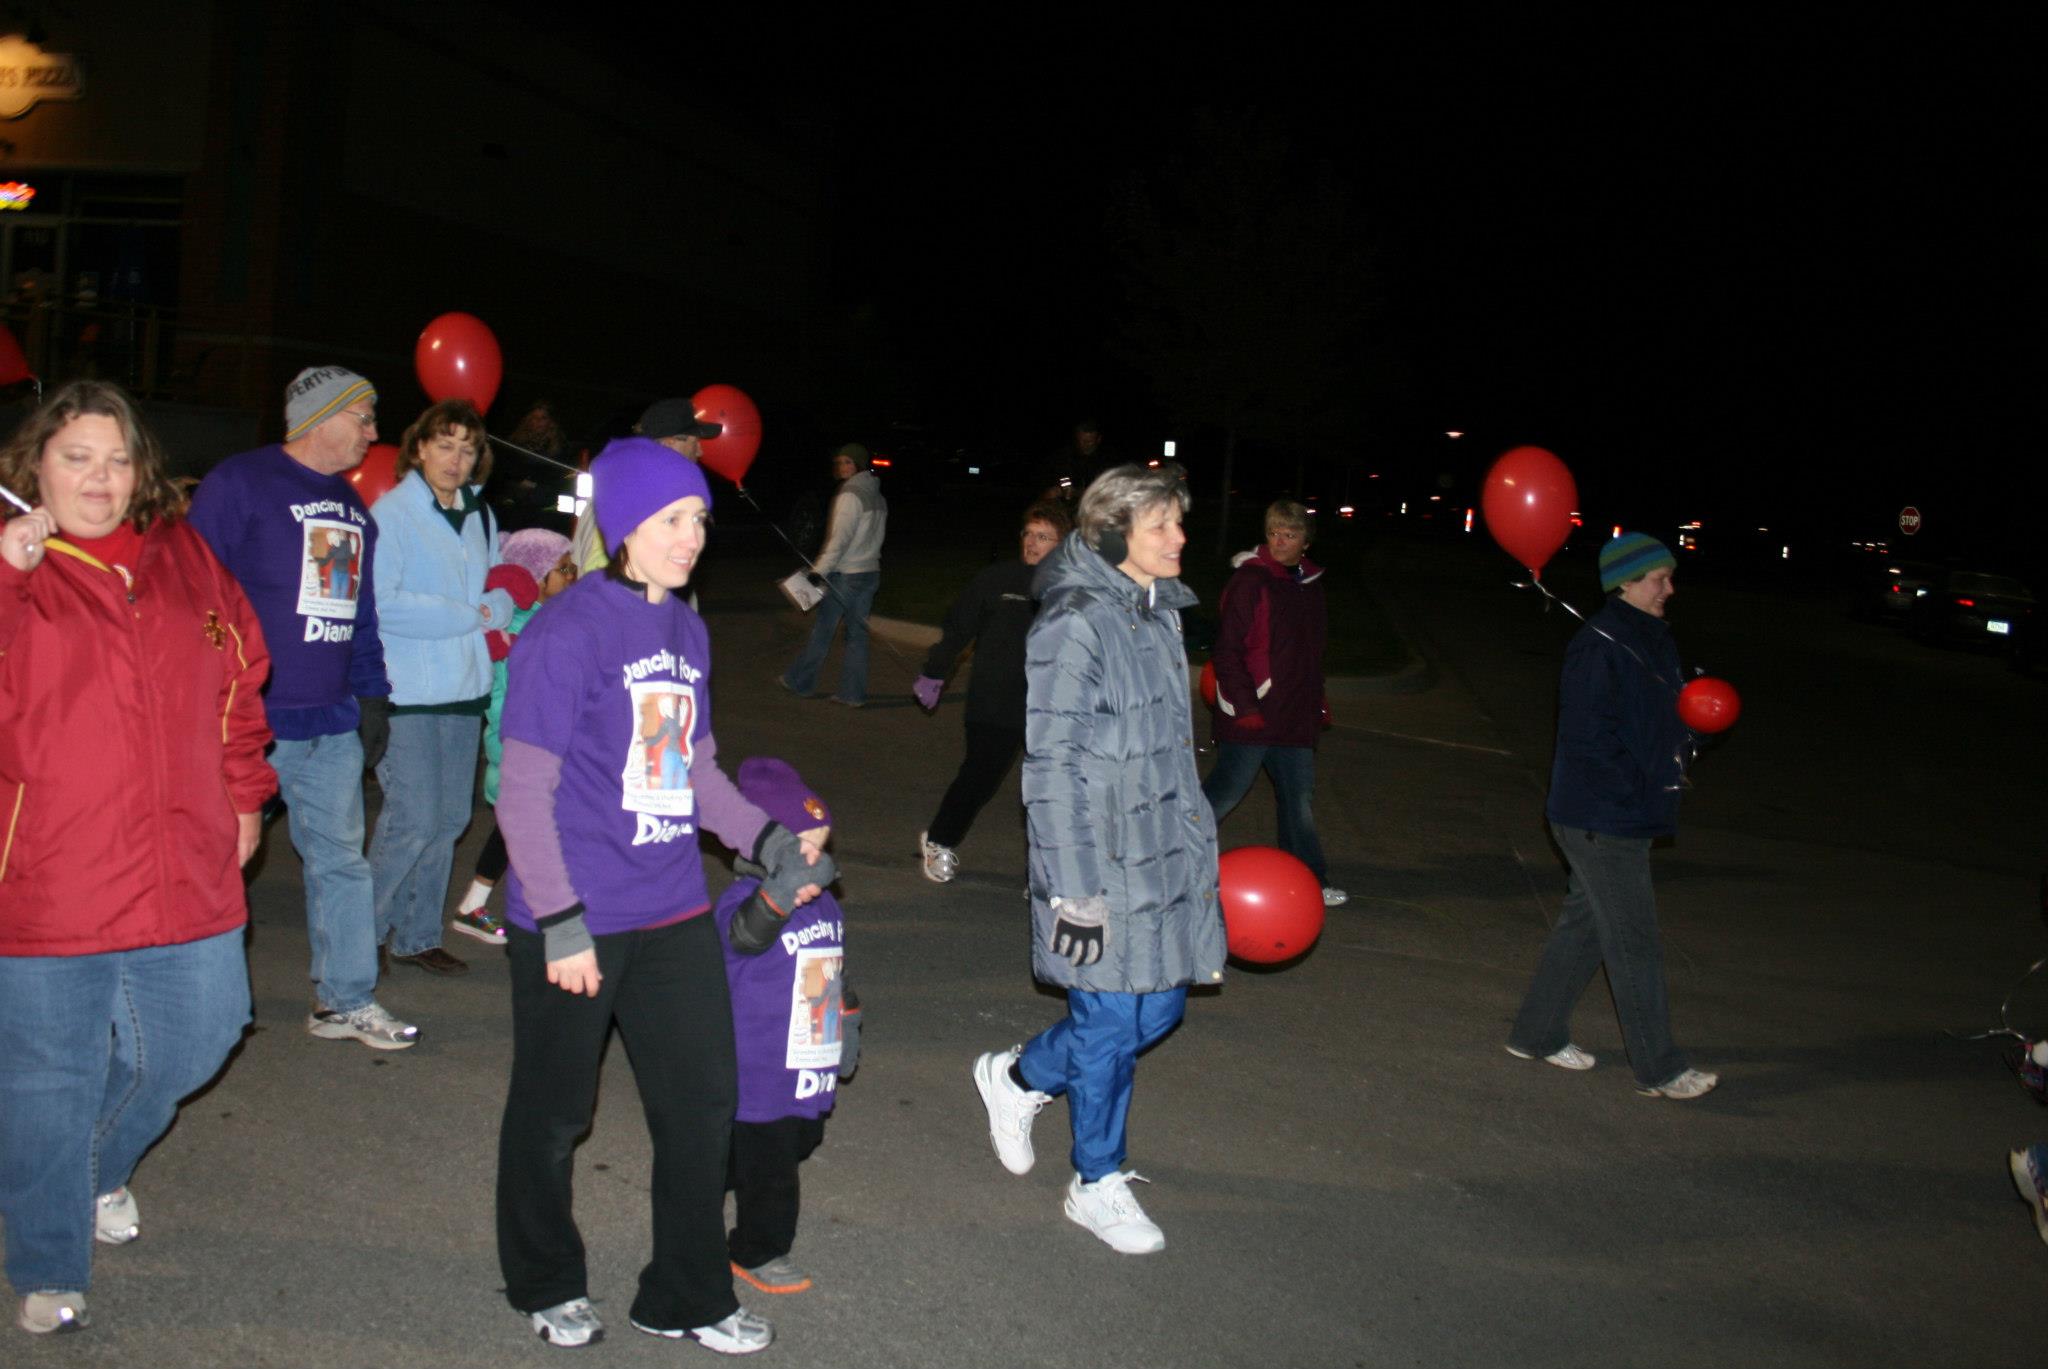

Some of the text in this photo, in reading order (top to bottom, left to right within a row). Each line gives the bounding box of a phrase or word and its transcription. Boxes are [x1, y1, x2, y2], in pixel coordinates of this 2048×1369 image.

[290, 499, 345, 522] Dancing
[1901, 515, 1917, 526] STOP
[303, 616, 353, 642] Diana
[680, 655, 702, 684] for
[781, 919, 834, 956] Dancing
